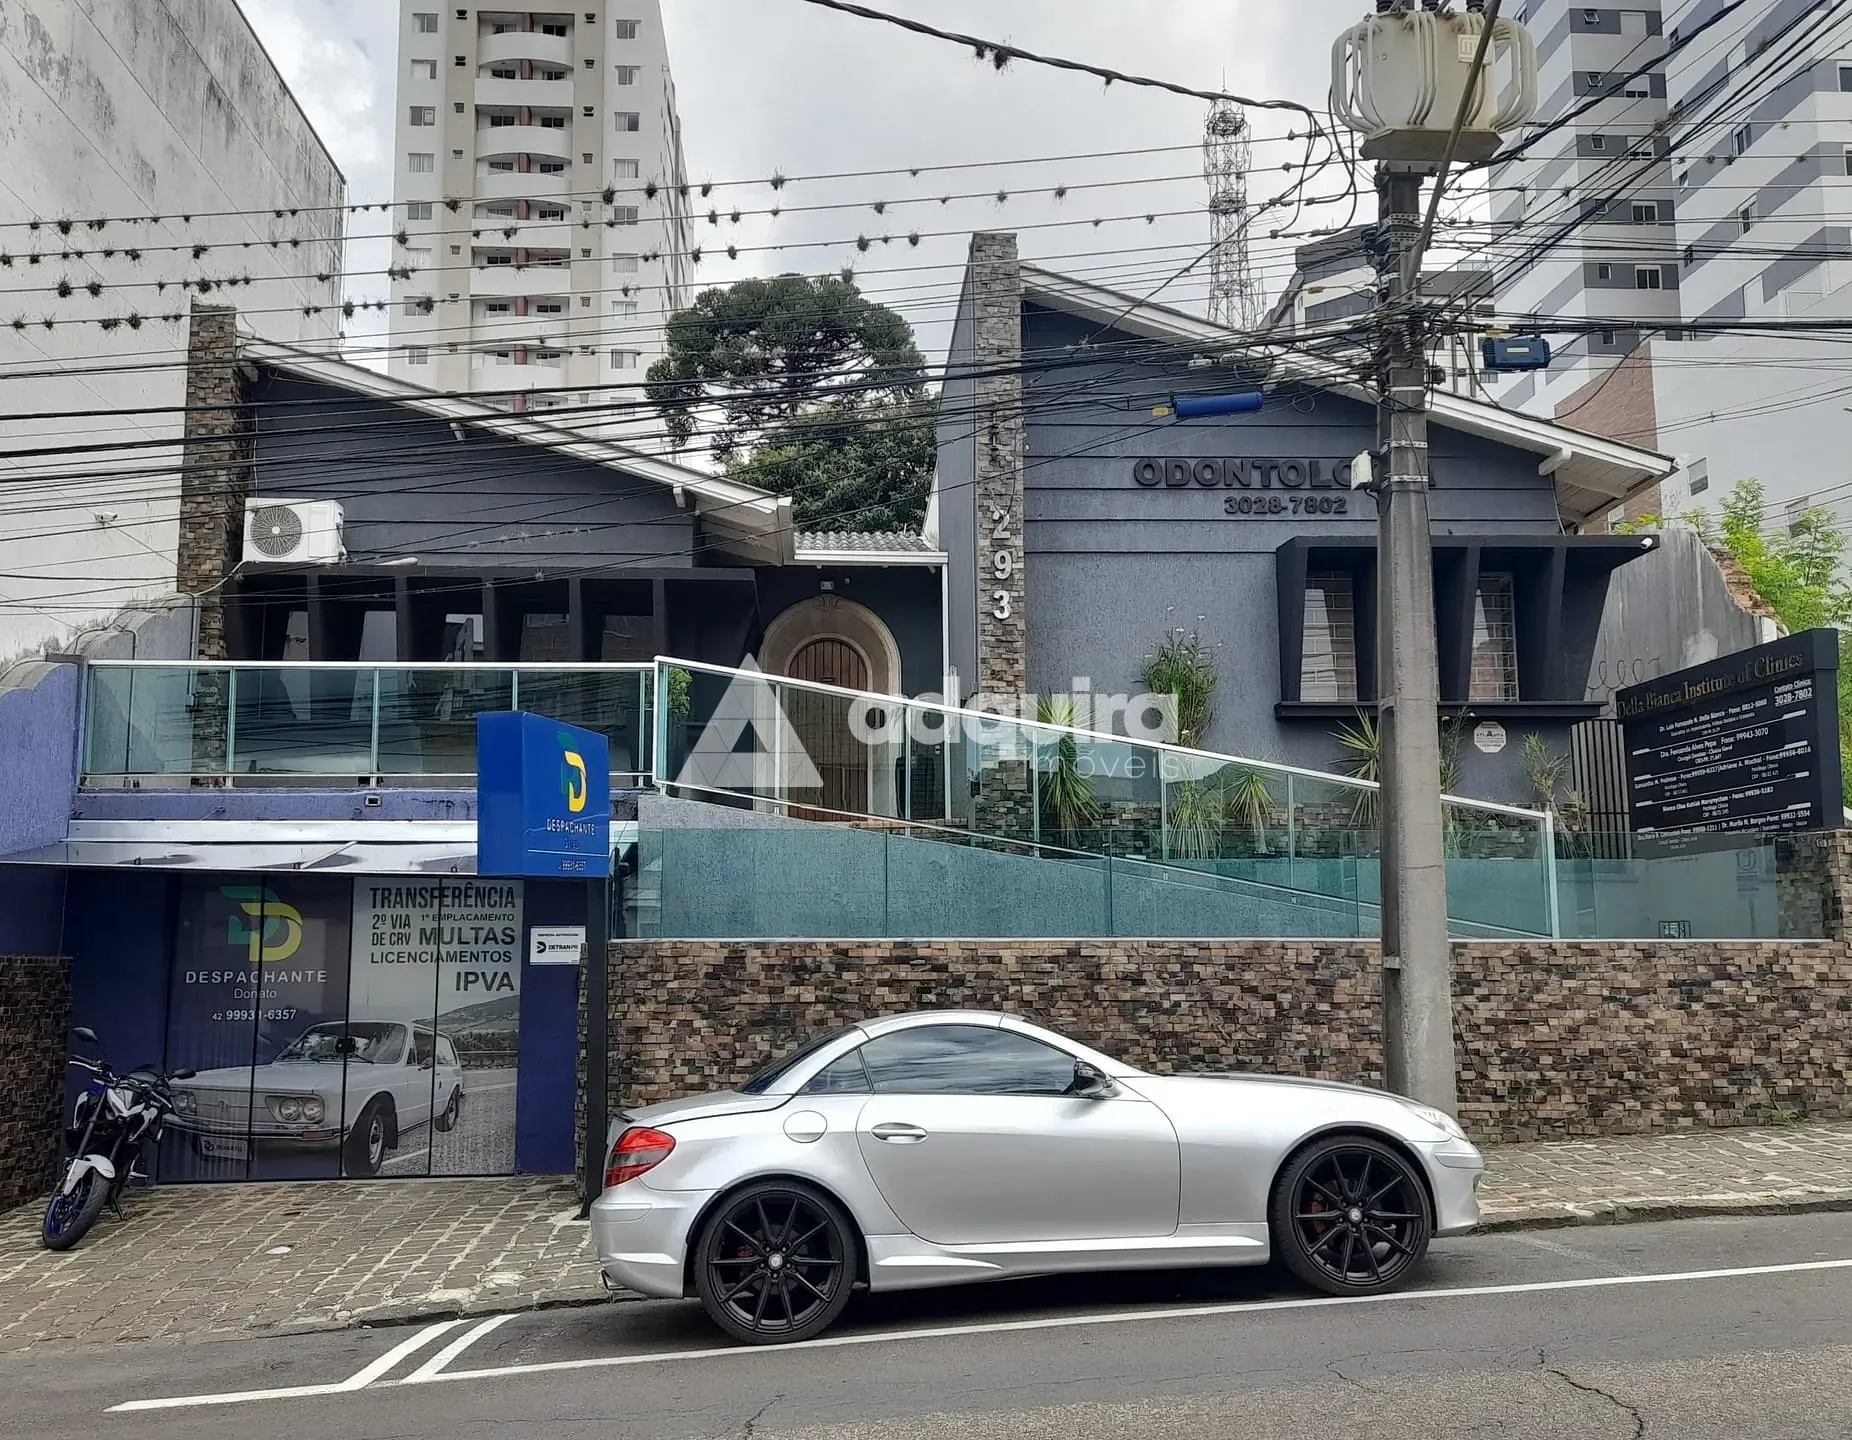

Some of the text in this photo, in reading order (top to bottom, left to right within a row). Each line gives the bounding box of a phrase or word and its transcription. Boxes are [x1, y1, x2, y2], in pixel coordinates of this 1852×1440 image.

[1133, 458, 1437, 488] ODONTOLO
[1224, 496, 1347, 515] 3028-7802
[991, 508, 1013, 620] 293
[1754, 654, 1803, 678] Clinics
[1774, 687, 1813, 705] 3028-7802
[546, 818, 595, 836] DESPACHANTE
[369, 881, 516, 909] TRANSFERÊNCIA
[390, 914, 412, 930] VIA
[432, 913, 515, 922] EMPLACAMENTO
[371, 931, 412, 946] DE CRV
[419, 926, 516, 946] MULTAS
[370, 950, 513, 964] LICENCIAMENTOS
[185, 971, 329, 984] DESPACHANTE
[455, 971, 516, 992] IPVA
[233, 988, 278, 999] Donato
